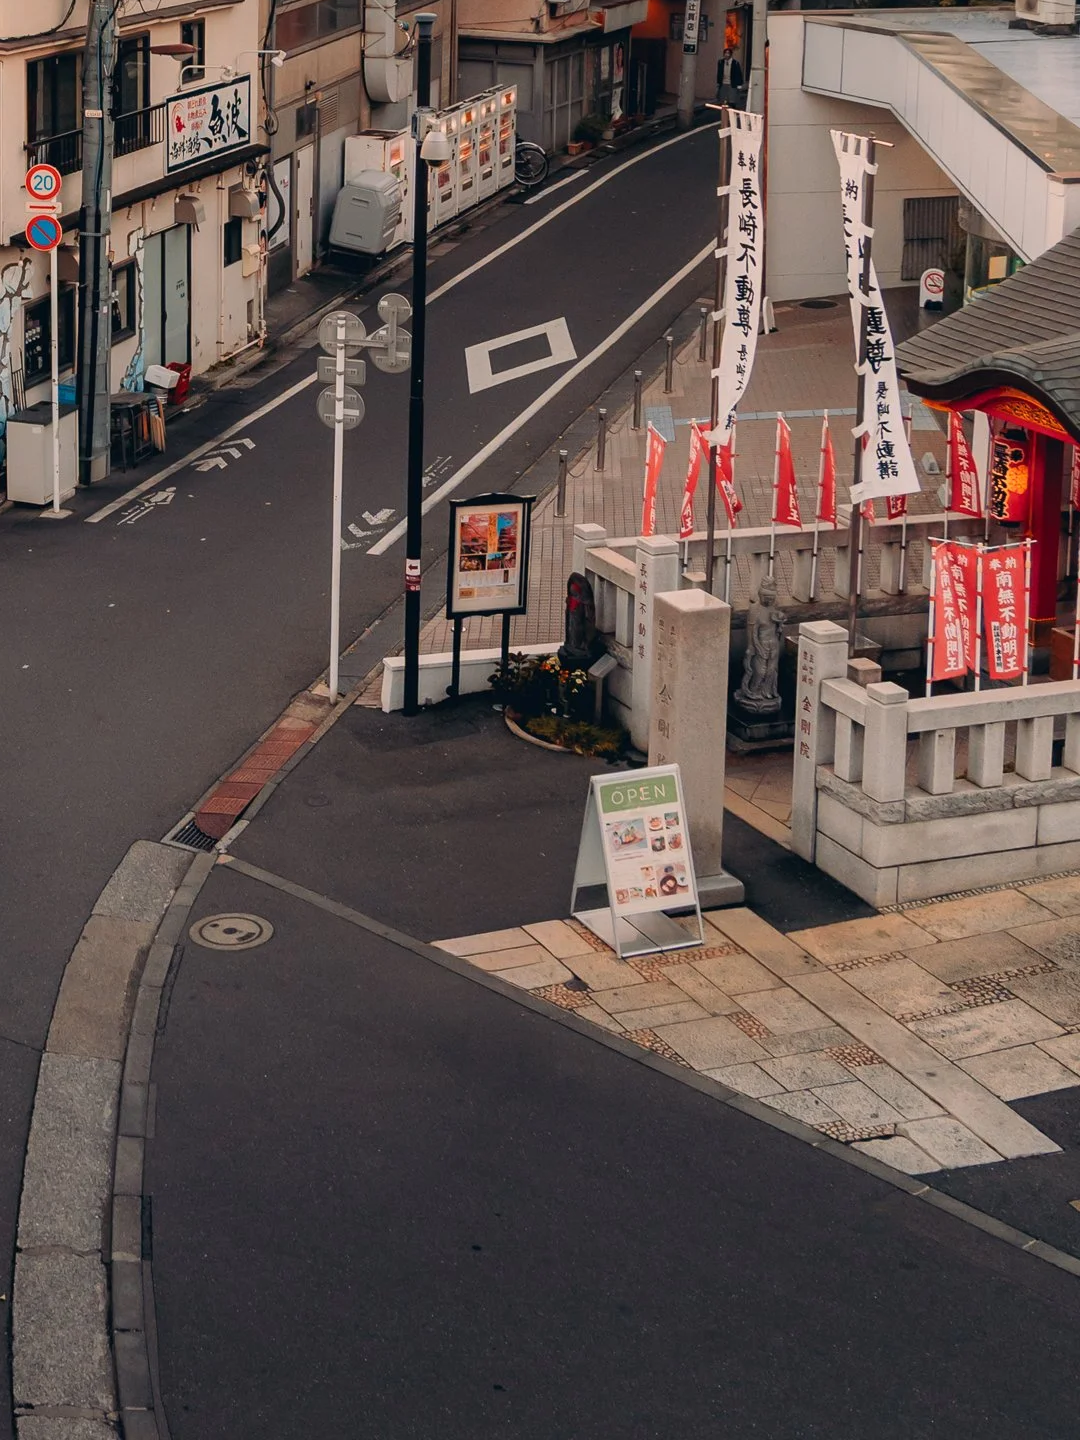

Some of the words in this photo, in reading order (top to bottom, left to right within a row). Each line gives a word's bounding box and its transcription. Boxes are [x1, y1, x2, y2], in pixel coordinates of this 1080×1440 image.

[201, 88, 248, 148] 魚波
[33, 174, 54, 191] 20
[732, 177, 758, 338] 長崎不動尊
[989, 556, 1017, 570] 奉納
[995, 571, 1019, 672] 南無不動明王
[799, 695, 812, 759] 金剛院
[611, 783, 666, 805] OPEN
